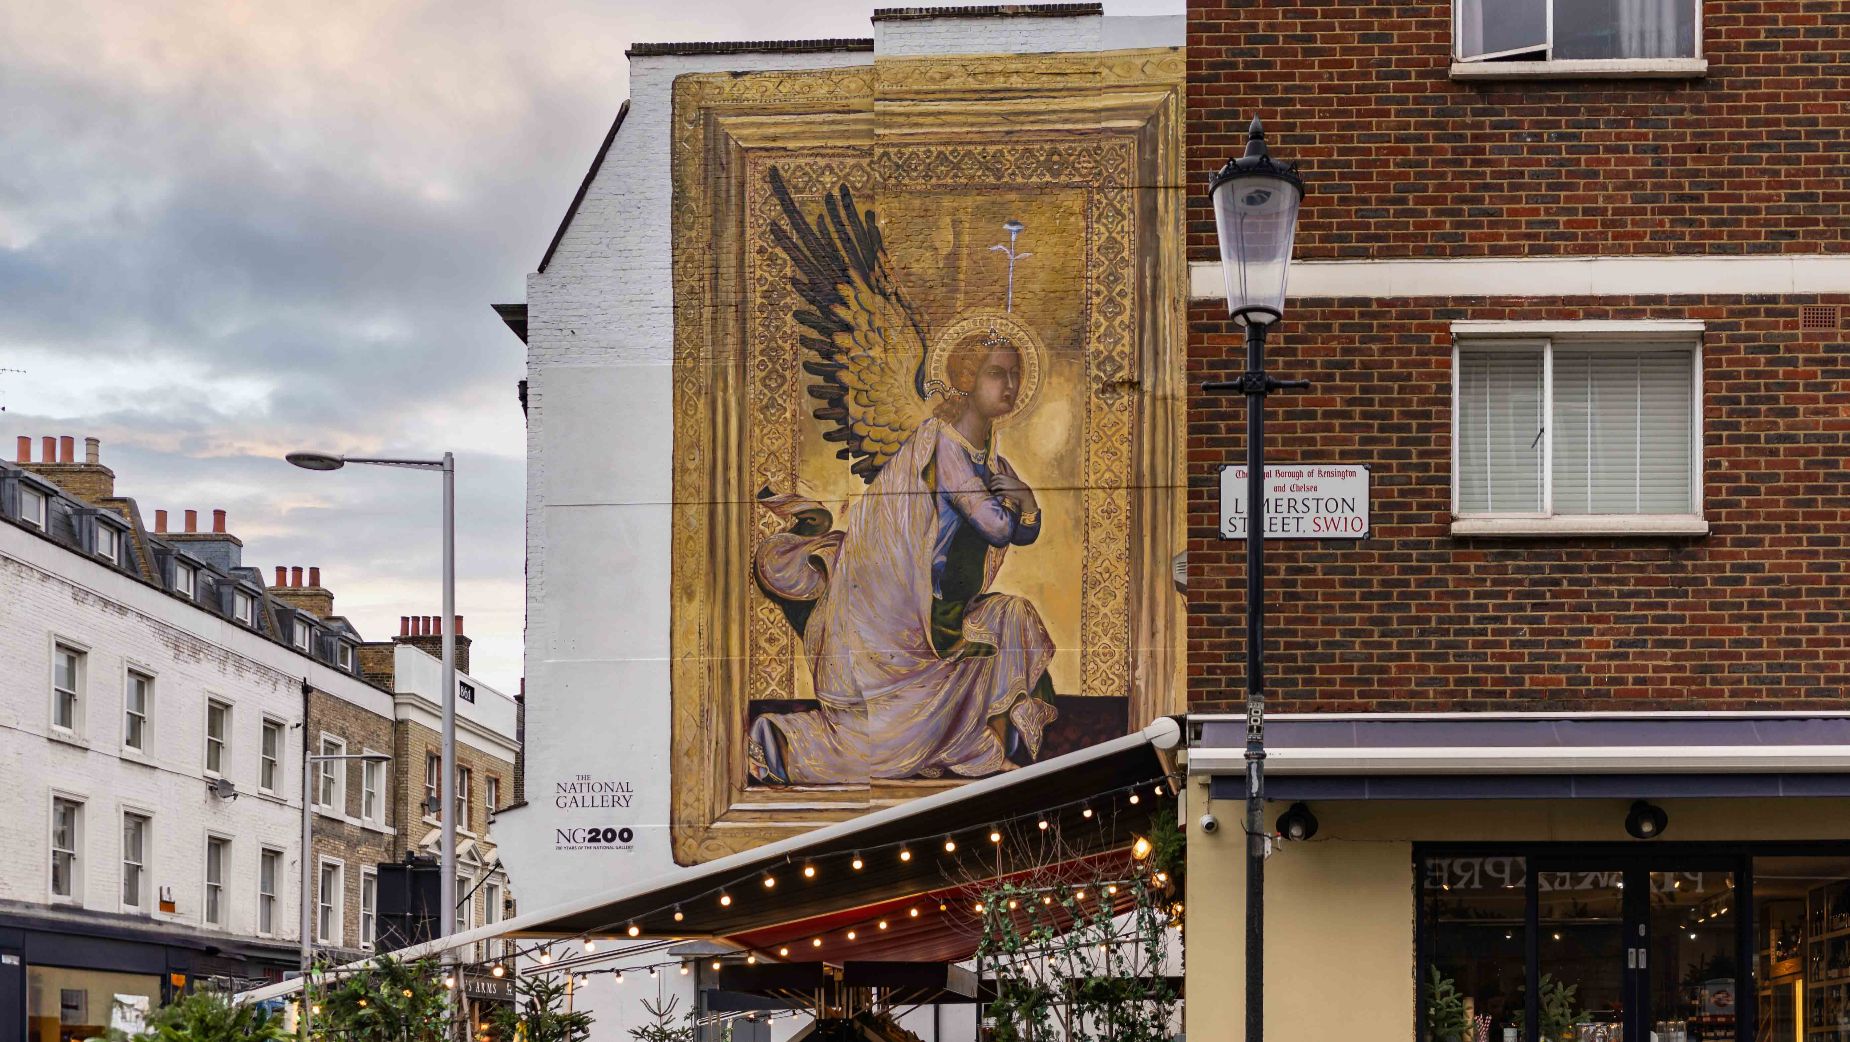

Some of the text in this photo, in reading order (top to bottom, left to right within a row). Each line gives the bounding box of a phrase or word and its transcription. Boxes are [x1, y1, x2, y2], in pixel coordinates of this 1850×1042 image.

[1275, 469, 1304, 481] Borough
[1307, 469, 1314, 478] of
[1317, 468, 1357, 480] Kensington
[1273, 483, 1318, 492] and Chelsea
[1235, 497, 1356, 514] LMERSTON
[556, 782, 633, 793] NATIONAL
[556, 795, 633, 808] GALLERY
[556, 828, 633, 843] NG200
[476, 982, 496, 994] ARMS
